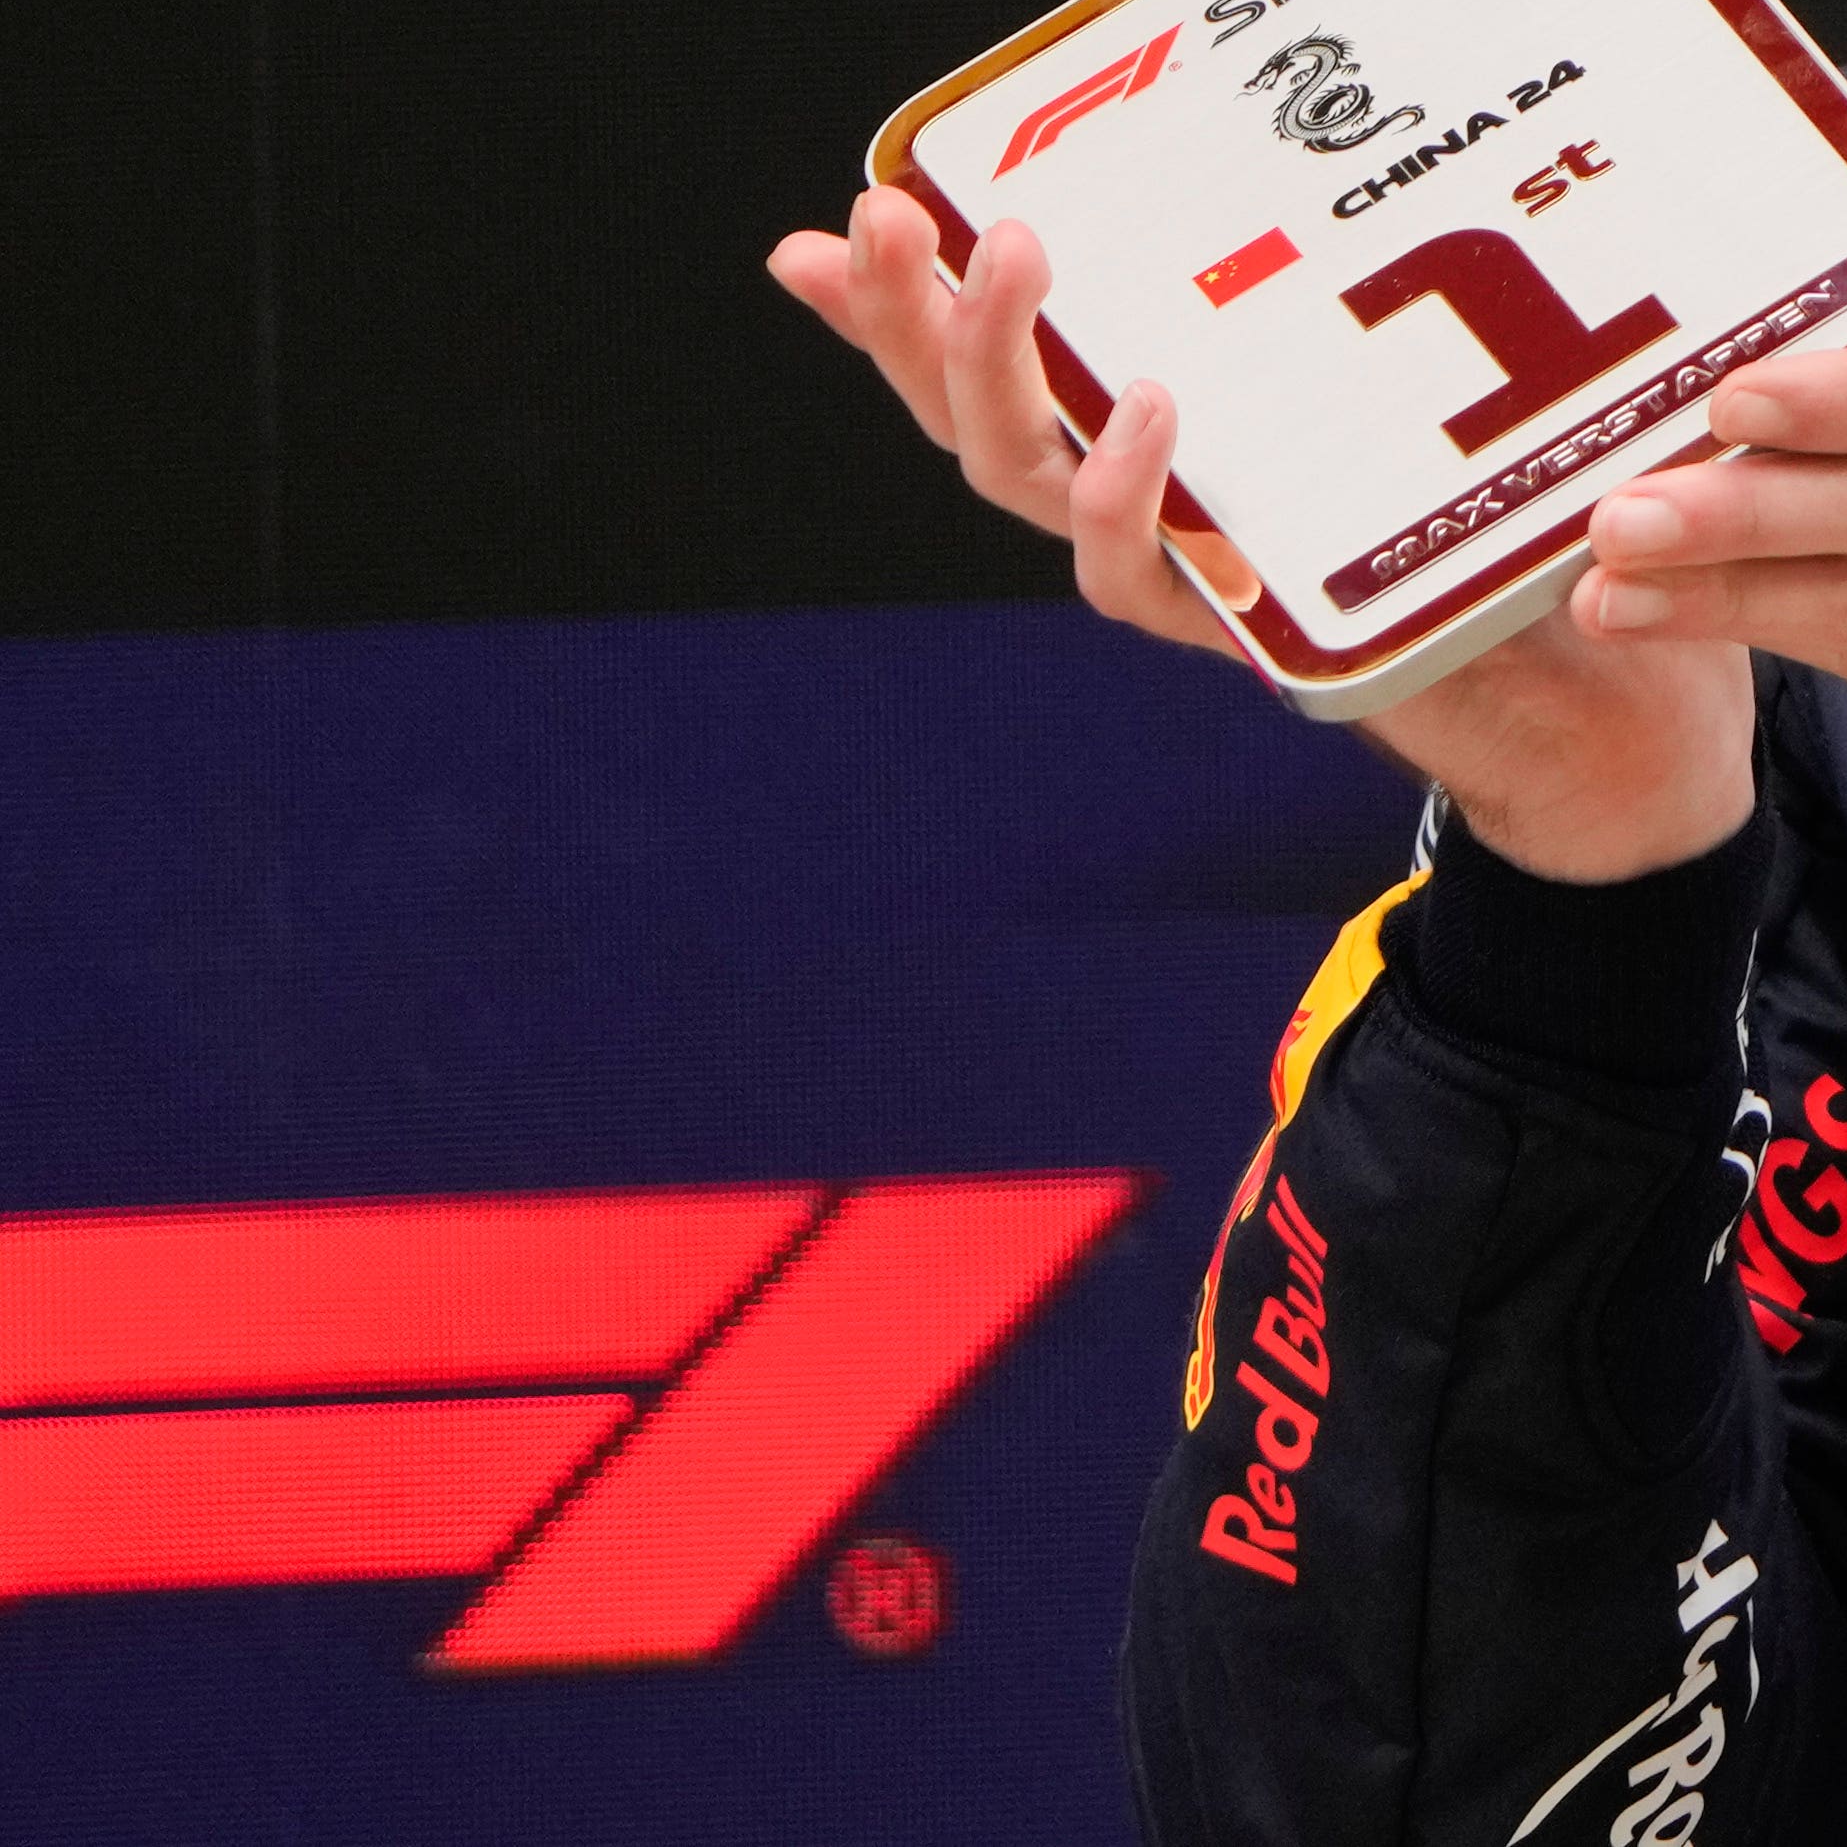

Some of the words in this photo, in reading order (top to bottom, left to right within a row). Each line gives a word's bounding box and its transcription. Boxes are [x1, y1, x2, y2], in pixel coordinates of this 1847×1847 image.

[991, 20, 1185, 183] F1
[1331, 111, 1512, 220] CHINA
[1507, 58, 1587, 114] 24
[1370, 486, 1505, 582] MAX
[1502, 279, 1838, 491] VERSTAPPEN
[1252, 1174, 1332, 1400] Bull
[1200, 1360, 1320, 1586] Red
